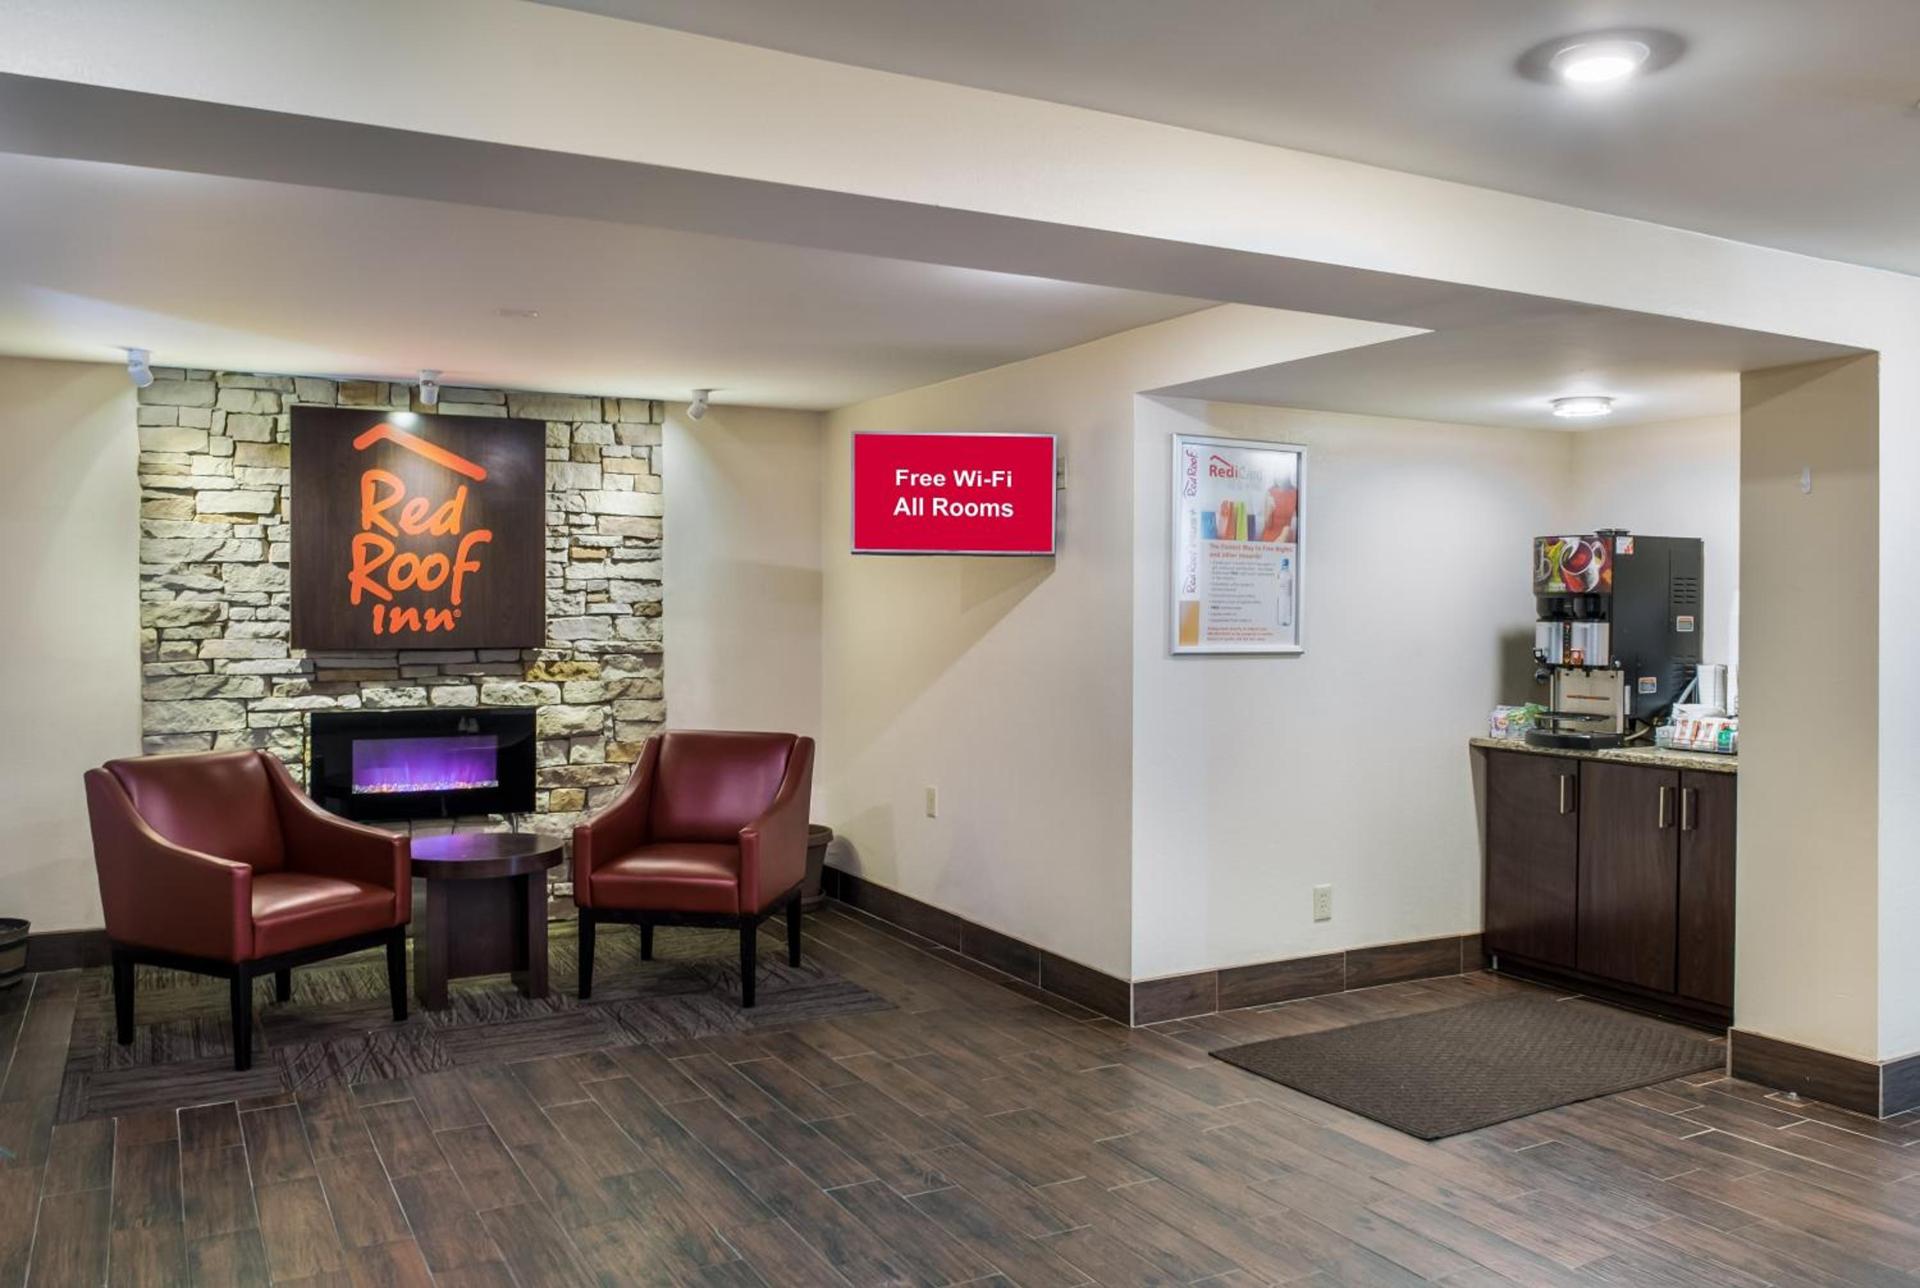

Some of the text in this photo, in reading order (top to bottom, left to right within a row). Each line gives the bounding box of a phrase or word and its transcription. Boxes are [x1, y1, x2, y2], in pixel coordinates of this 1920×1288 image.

[1186, 448, 1198, 478] Roof
[895, 469, 1013, 488] Free Wi-Fi
[1186, 478, 1198, 497] Red
[361, 469, 468, 537] Red
[893, 497, 1014, 518] All Rooms
[348, 529, 493, 605] Roof
